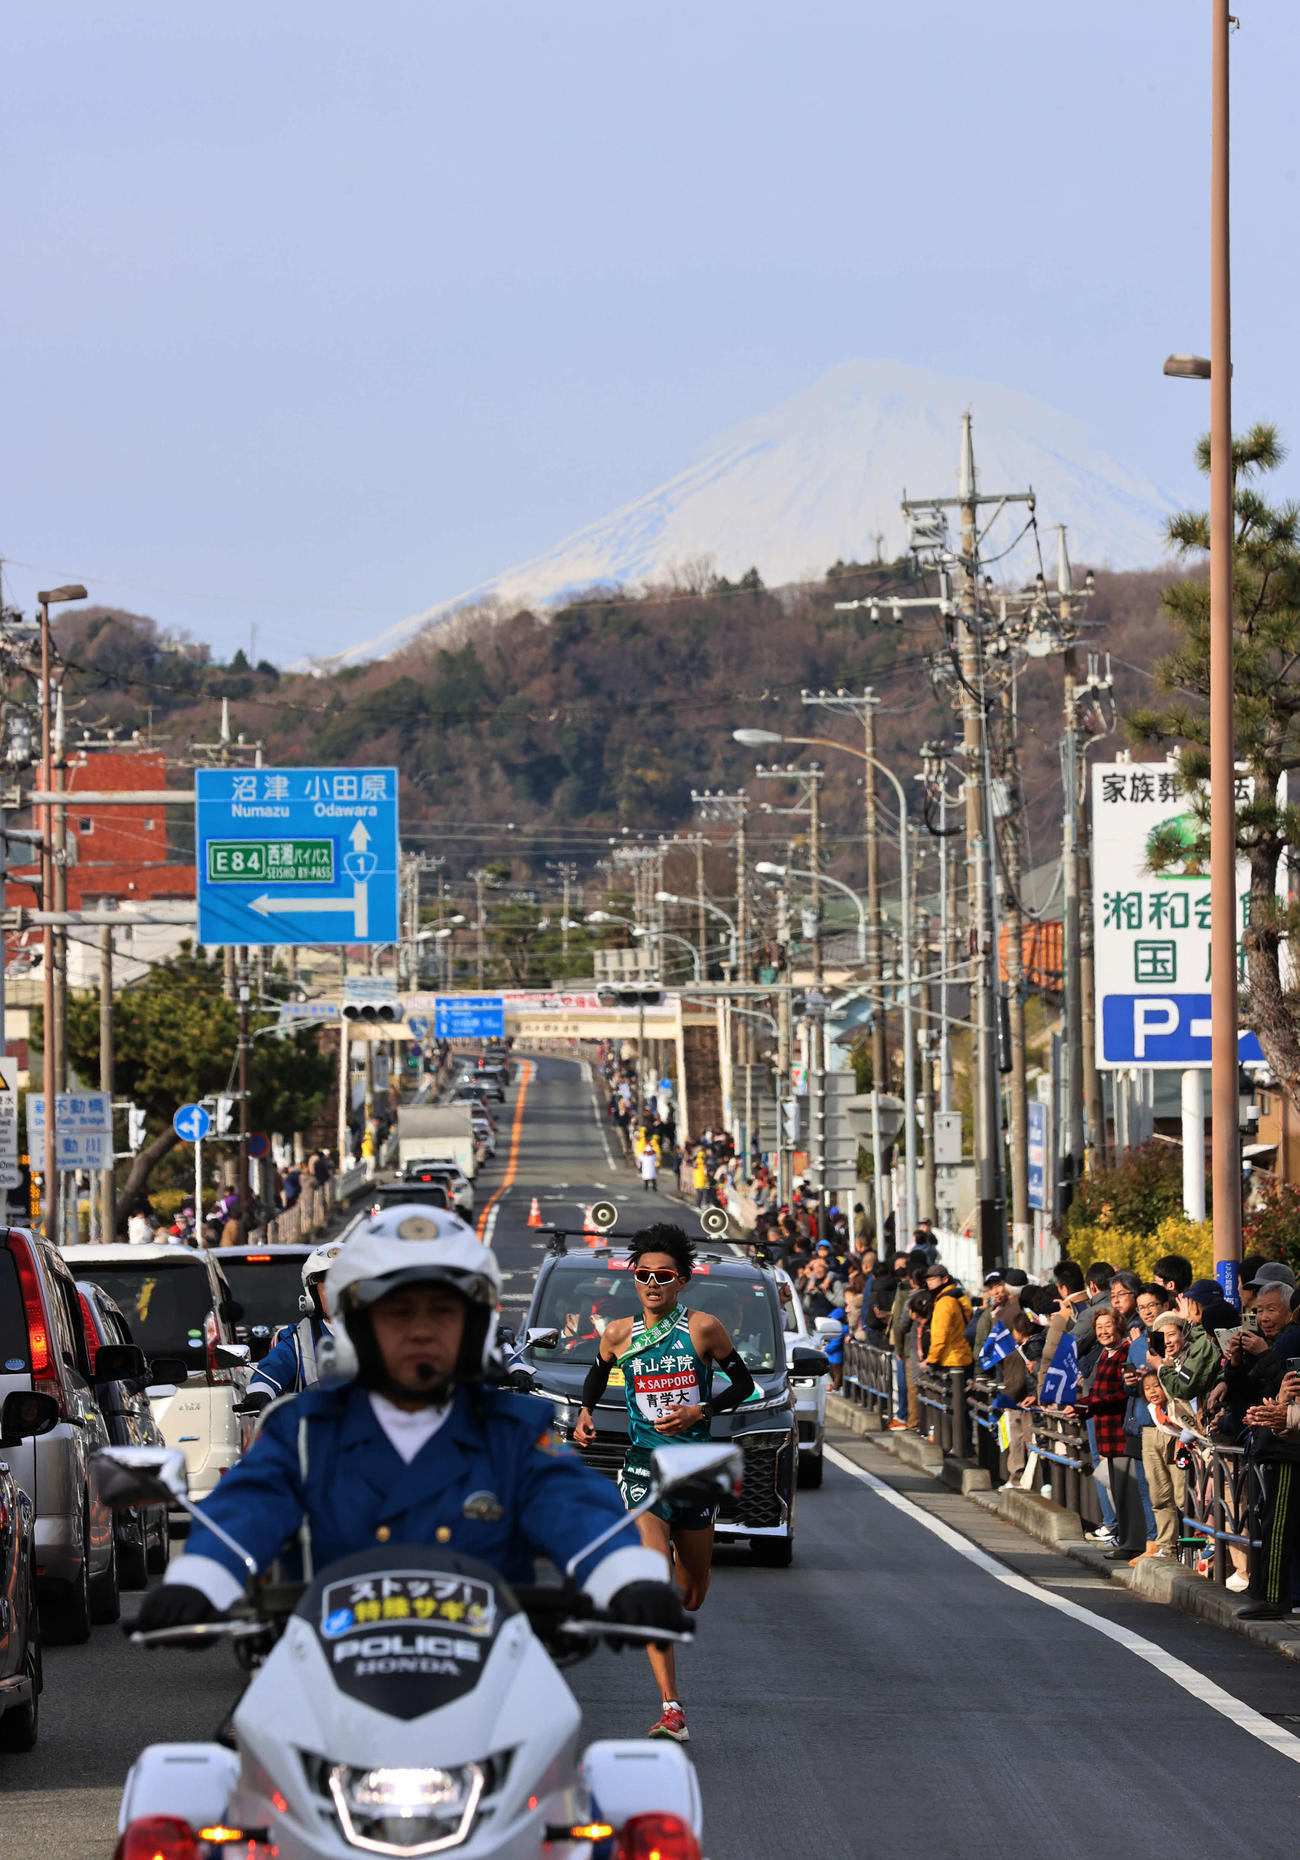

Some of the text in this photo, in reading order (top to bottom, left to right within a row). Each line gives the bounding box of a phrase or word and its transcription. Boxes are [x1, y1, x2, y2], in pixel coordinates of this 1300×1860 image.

[232, 775, 387, 801] 沼津 小田原
[232, 803, 377, 817] Numazu Odawara
[216, 851, 261, 872] E84
[357, 857, 364, 874] 1
[267, 866, 332, 879] SEISHO BY-PASS
[1134, 998, 1180, 1058] P
[629, 1354, 695, 1376] 青山学院
[647, 1374, 696, 1390] SAPPORO
[646, 1390, 690, 1408] 青学大
[333, 1635, 481, 1663] POLICE
[354, 1658, 461, 1677] HONDA
